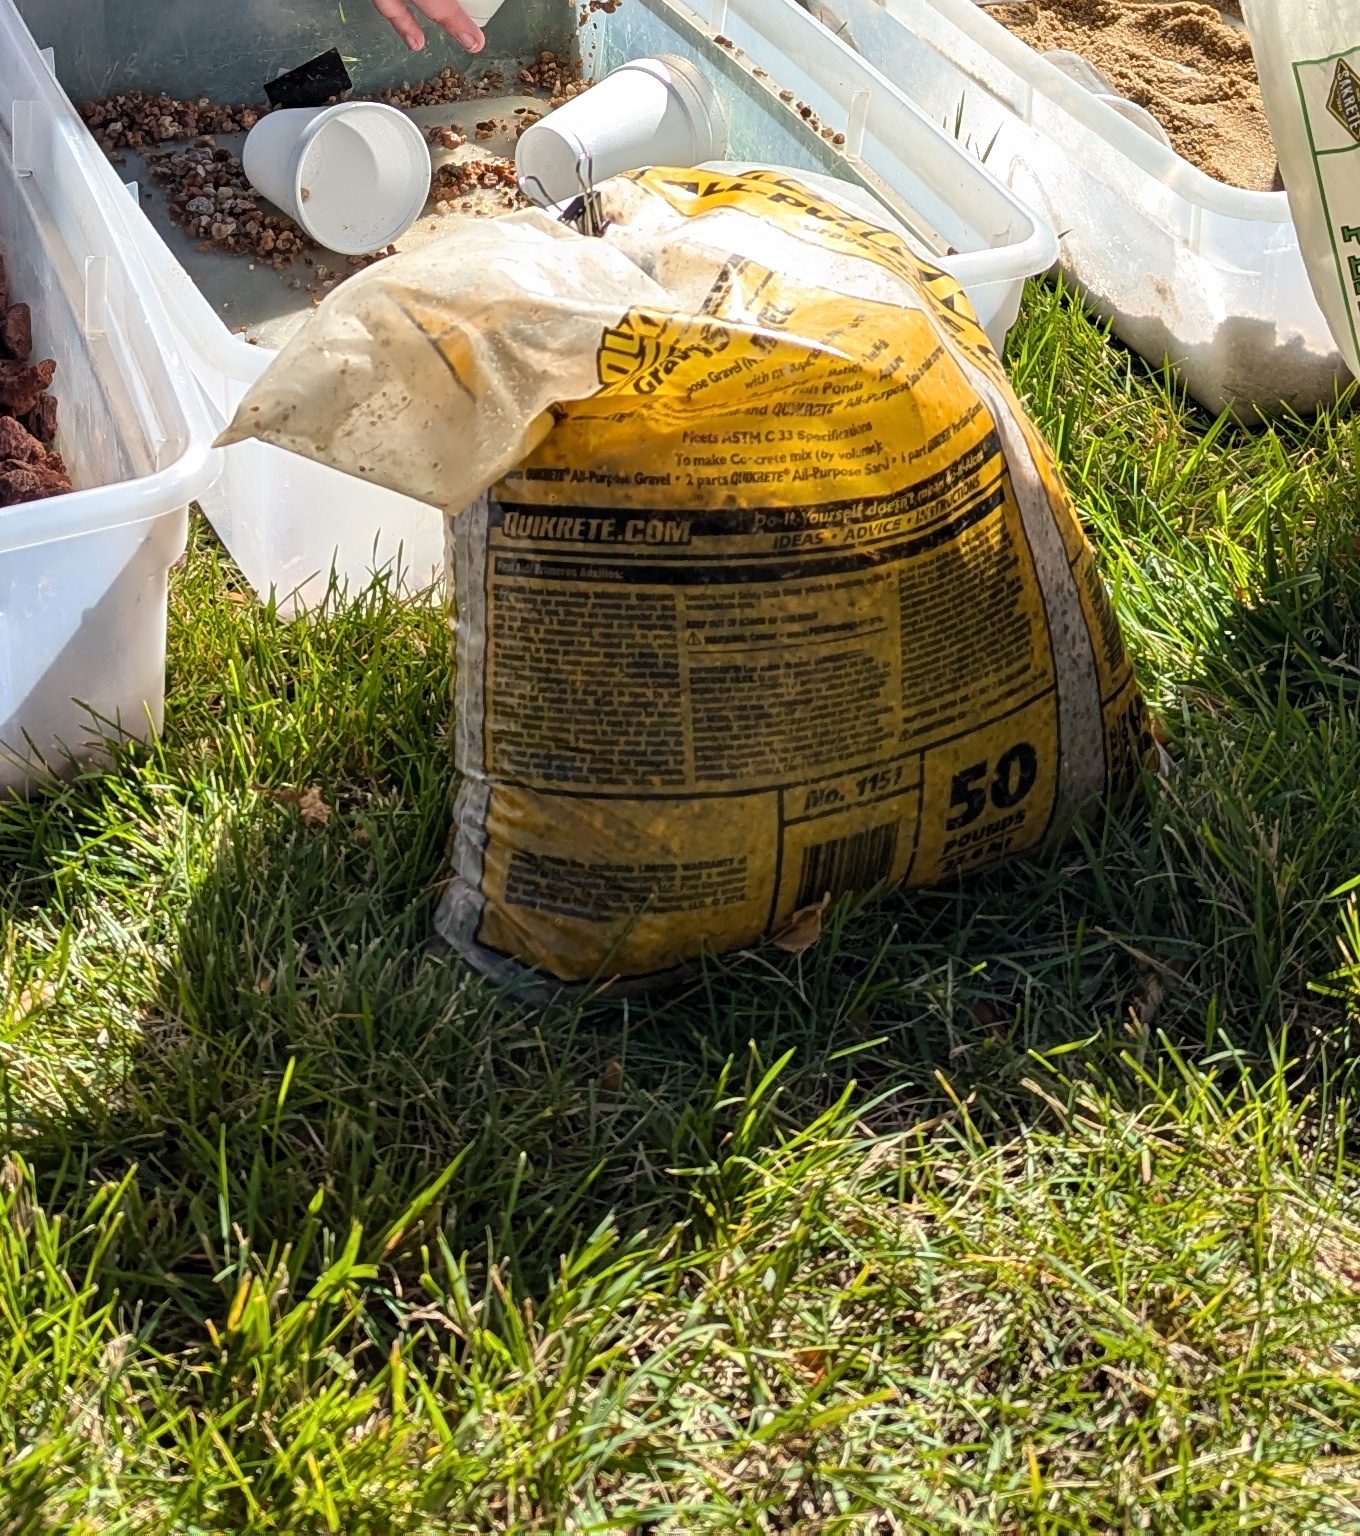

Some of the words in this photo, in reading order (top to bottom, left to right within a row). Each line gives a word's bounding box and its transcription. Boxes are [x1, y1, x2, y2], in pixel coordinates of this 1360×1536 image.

[822, 380, 865, 396] Ponds
[721, 432, 761, 445] ASTM
[765, 430, 776, 442] C
[778, 430, 794, 441] 33
[797, 421, 873, 443] Specifications
[675, 452, 690, 466] To
[693, 453, 727, 467] make
[790, 448, 812, 462] mix
[634, 471, 671, 486] Gravel
[686, 473, 694, 485] 2
[696, 473, 729, 488] parts
[792, 466, 861, 483] All-Purpose
[504, 511, 692, 543] QUIKRETE.COM
[773, 531, 825, 550] IDEAS
[843, 517, 902, 543] ADVICE
[804, 787, 846, 813] No.
[945, 741, 1038, 833] 50
[942, 810, 1027, 856] POUNDS
